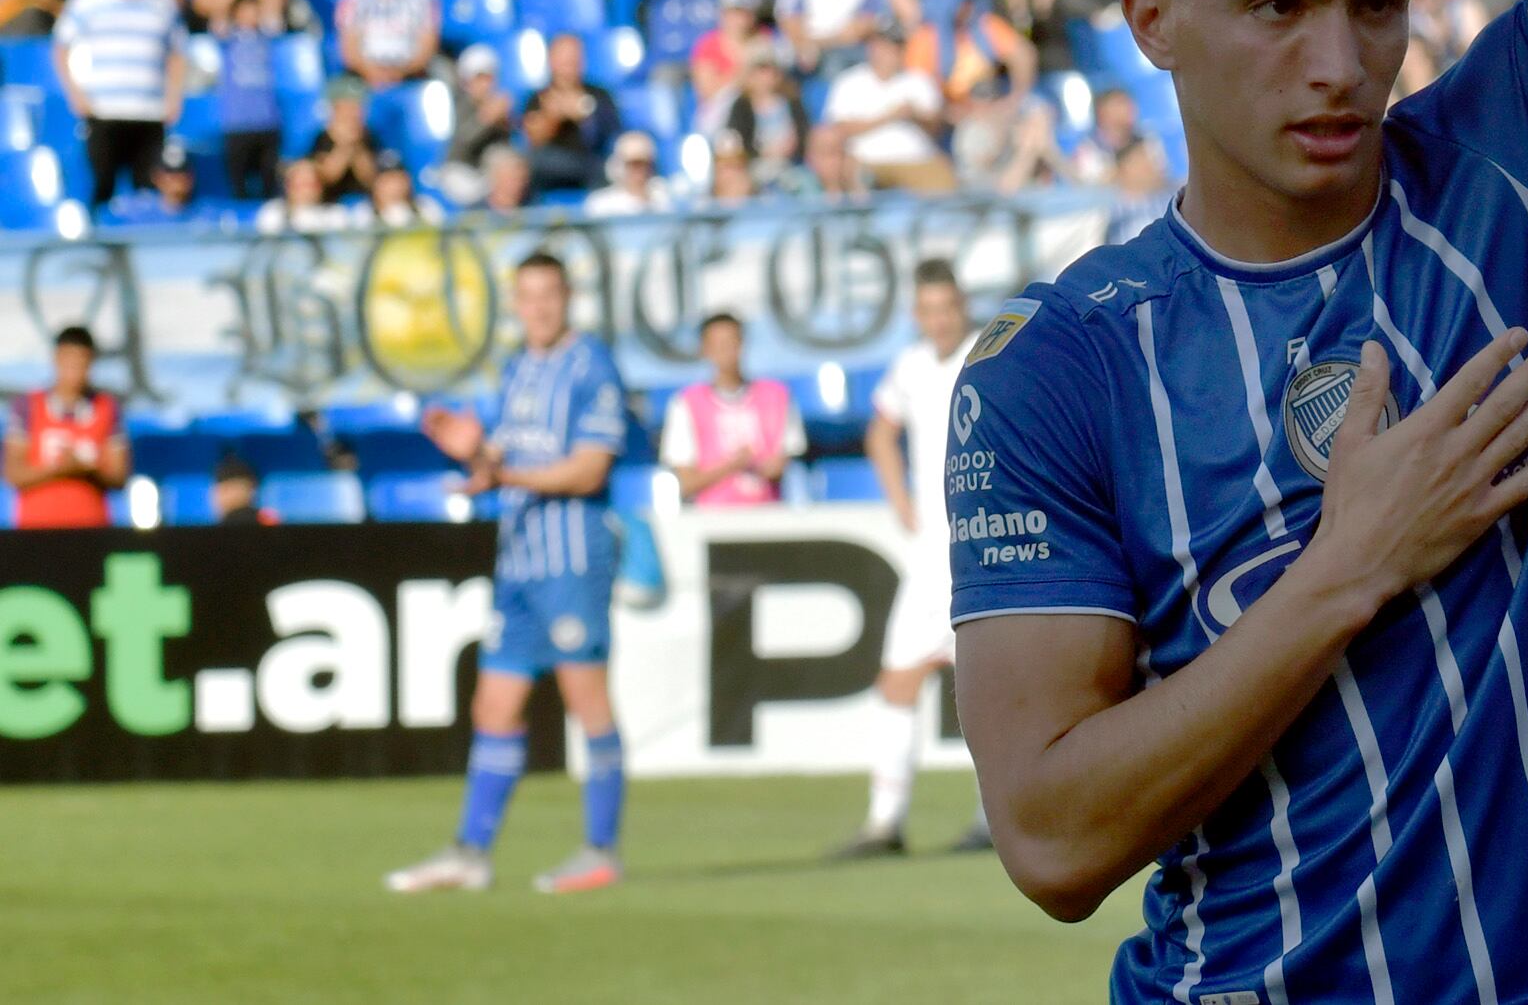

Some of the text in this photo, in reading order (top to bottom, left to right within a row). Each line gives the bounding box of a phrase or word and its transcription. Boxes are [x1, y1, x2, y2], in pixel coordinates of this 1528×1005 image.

[1313, 365, 1332, 377] CRUZ
[948, 471, 993, 495] CRUZ
[979, 542, 1050, 565] .news
[0, 552, 494, 739] et.ar
